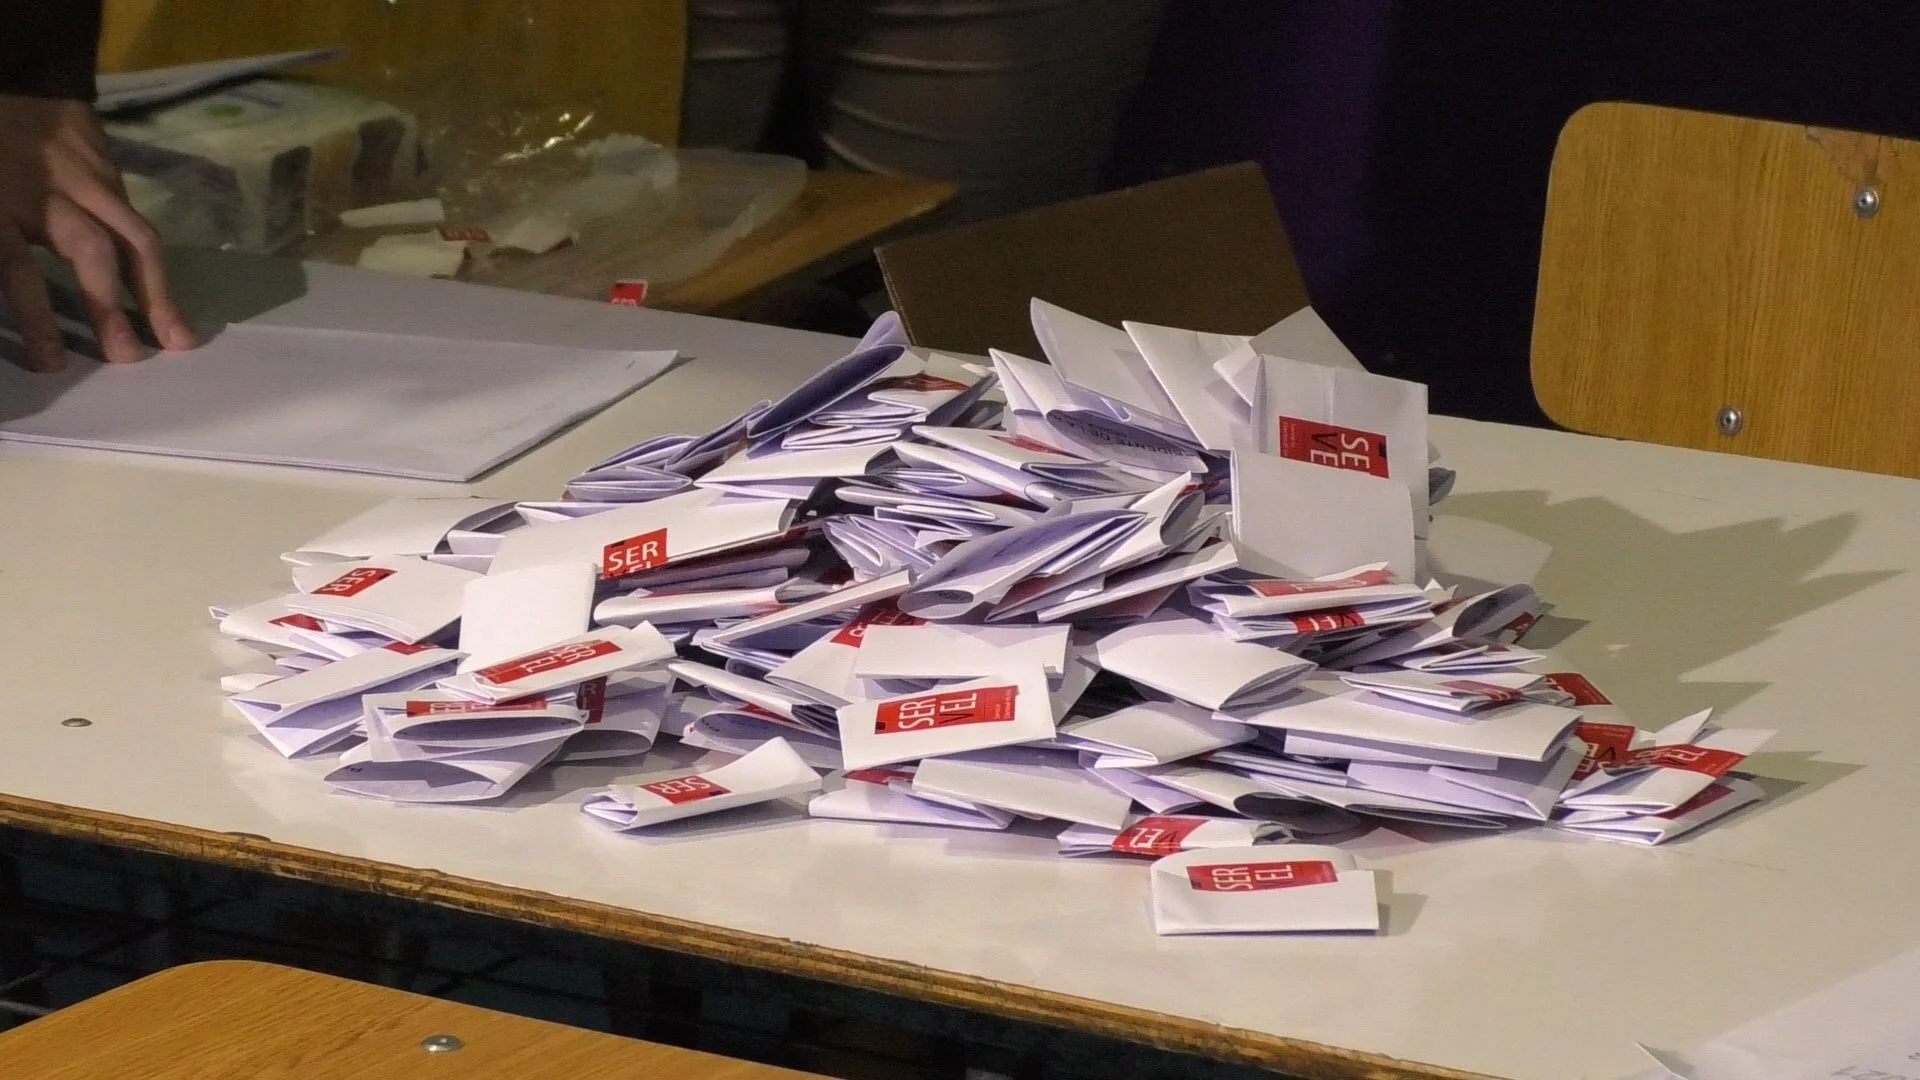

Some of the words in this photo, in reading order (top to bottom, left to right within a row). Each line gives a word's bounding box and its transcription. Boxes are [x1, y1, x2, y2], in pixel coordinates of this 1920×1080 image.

[607, 540, 659, 573] SER
[321, 569, 377, 592] SER
[898, 697, 937, 730] SER
[938, 692, 978, 725] VEL
[650, 776, 712, 795] SER
[1211, 866, 1254, 891] SER
